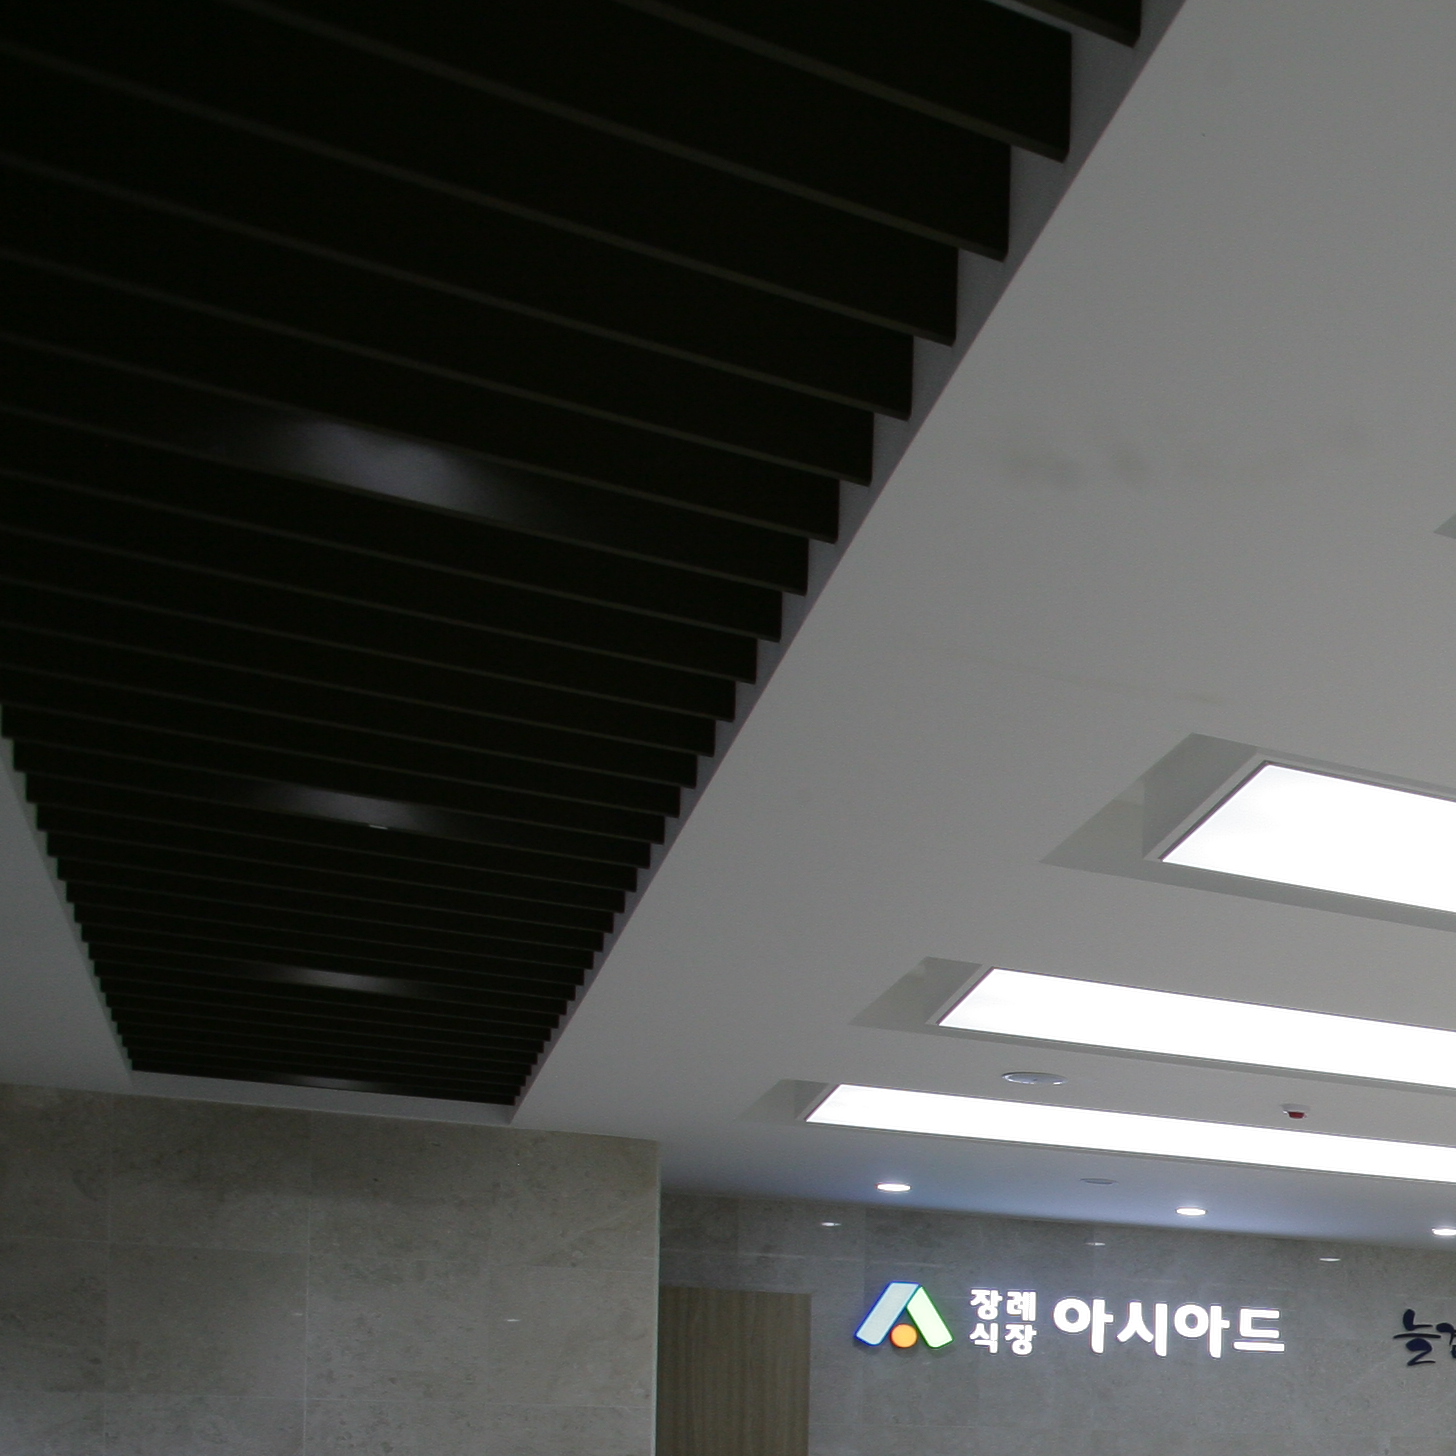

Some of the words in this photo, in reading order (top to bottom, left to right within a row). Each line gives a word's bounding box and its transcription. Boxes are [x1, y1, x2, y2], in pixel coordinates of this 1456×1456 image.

[970, 1289, 1037, 1321] 장례
[969, 1322, 1037, 1355] 식장
[1053, 1298, 1285, 1358] 아시아드
